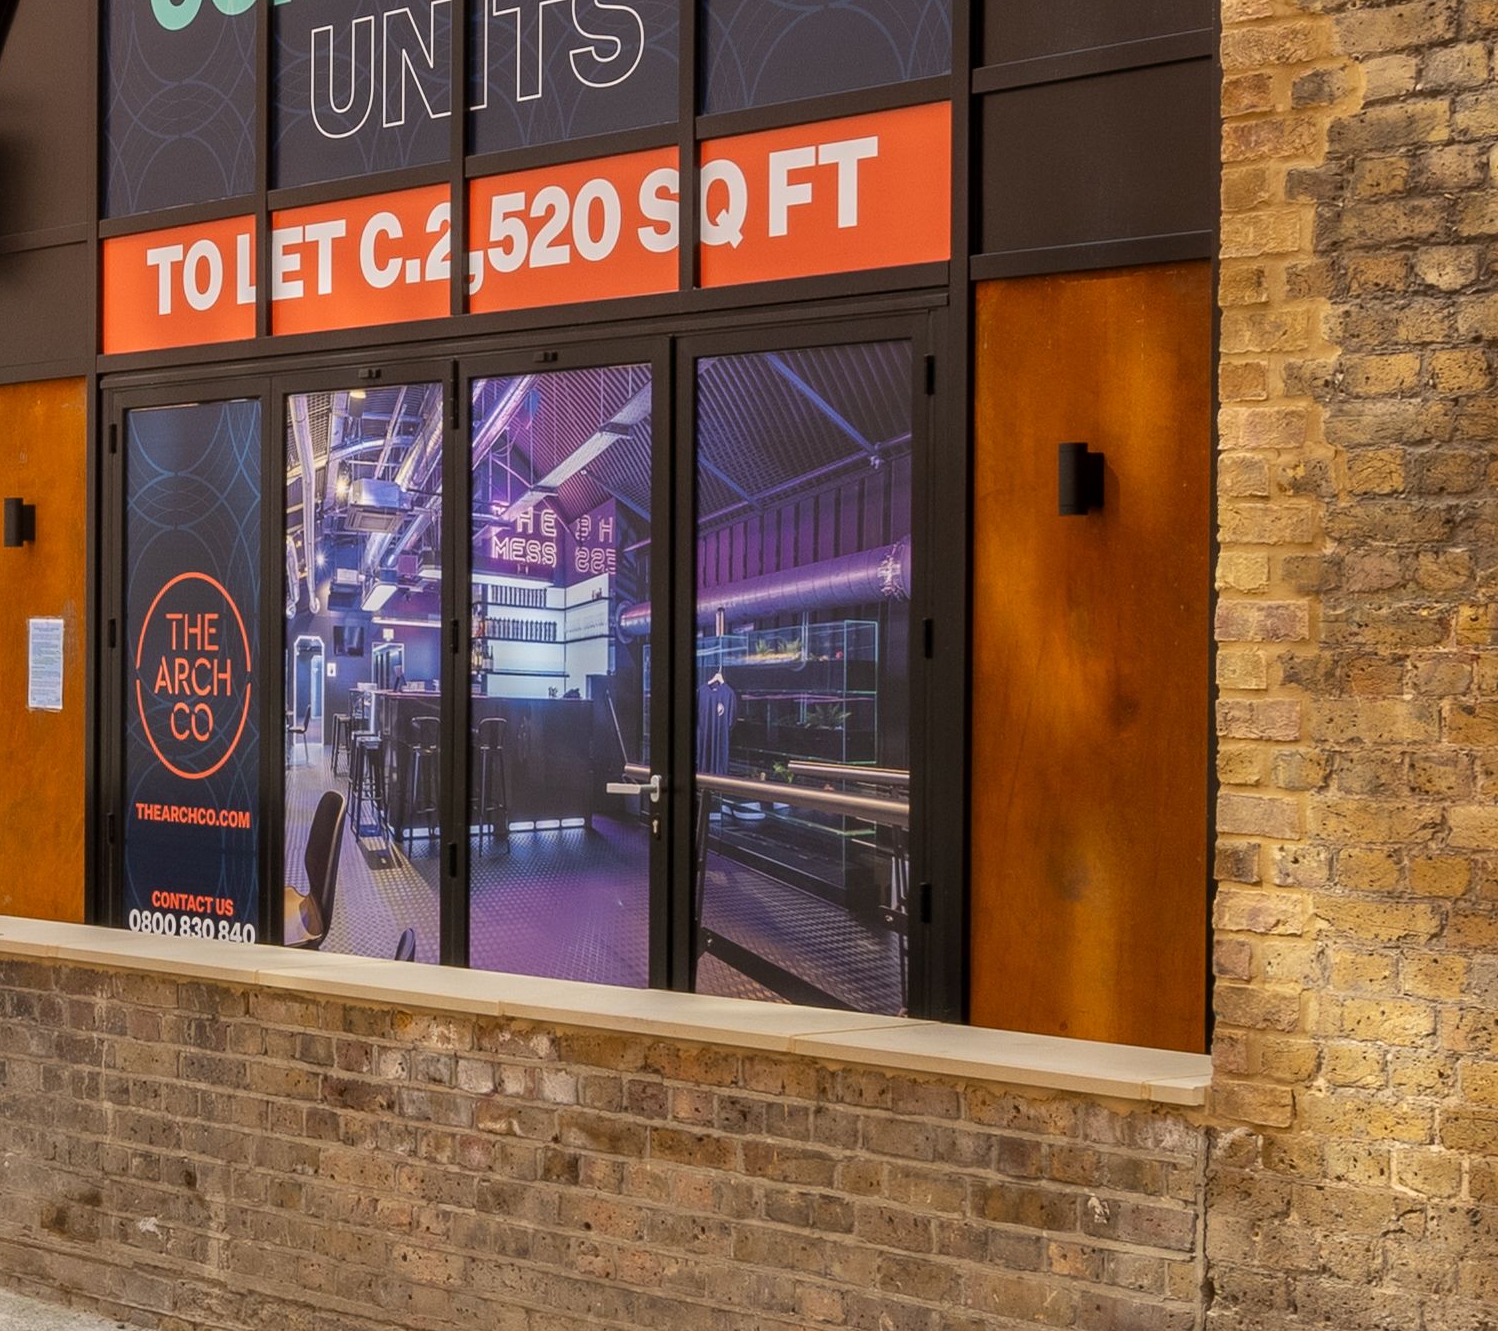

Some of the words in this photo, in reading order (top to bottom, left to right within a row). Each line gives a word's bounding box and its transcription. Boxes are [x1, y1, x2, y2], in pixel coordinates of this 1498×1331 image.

[146, 239, 224, 316] TO
[236, 218, 346, 305] LET
[359, 178, 622, 296] C.2,520
[637, 158, 748, 253] SQ
[767, 134, 879, 239] FT
[491, 536, 557, 568] MESS
[165, 613, 219, 652] THE
[154, 655, 232, 697] ARCH
[170, 701, 214, 742] CO
[135, 802, 251, 830] THEARCHCO.COM
[151, 890, 213, 914] CONTACT
[215, 897, 234, 917] US
[129, 908, 177, 937] 0800
[179, 914, 215, 940] 830
[218, 920, 256, 944] 840
